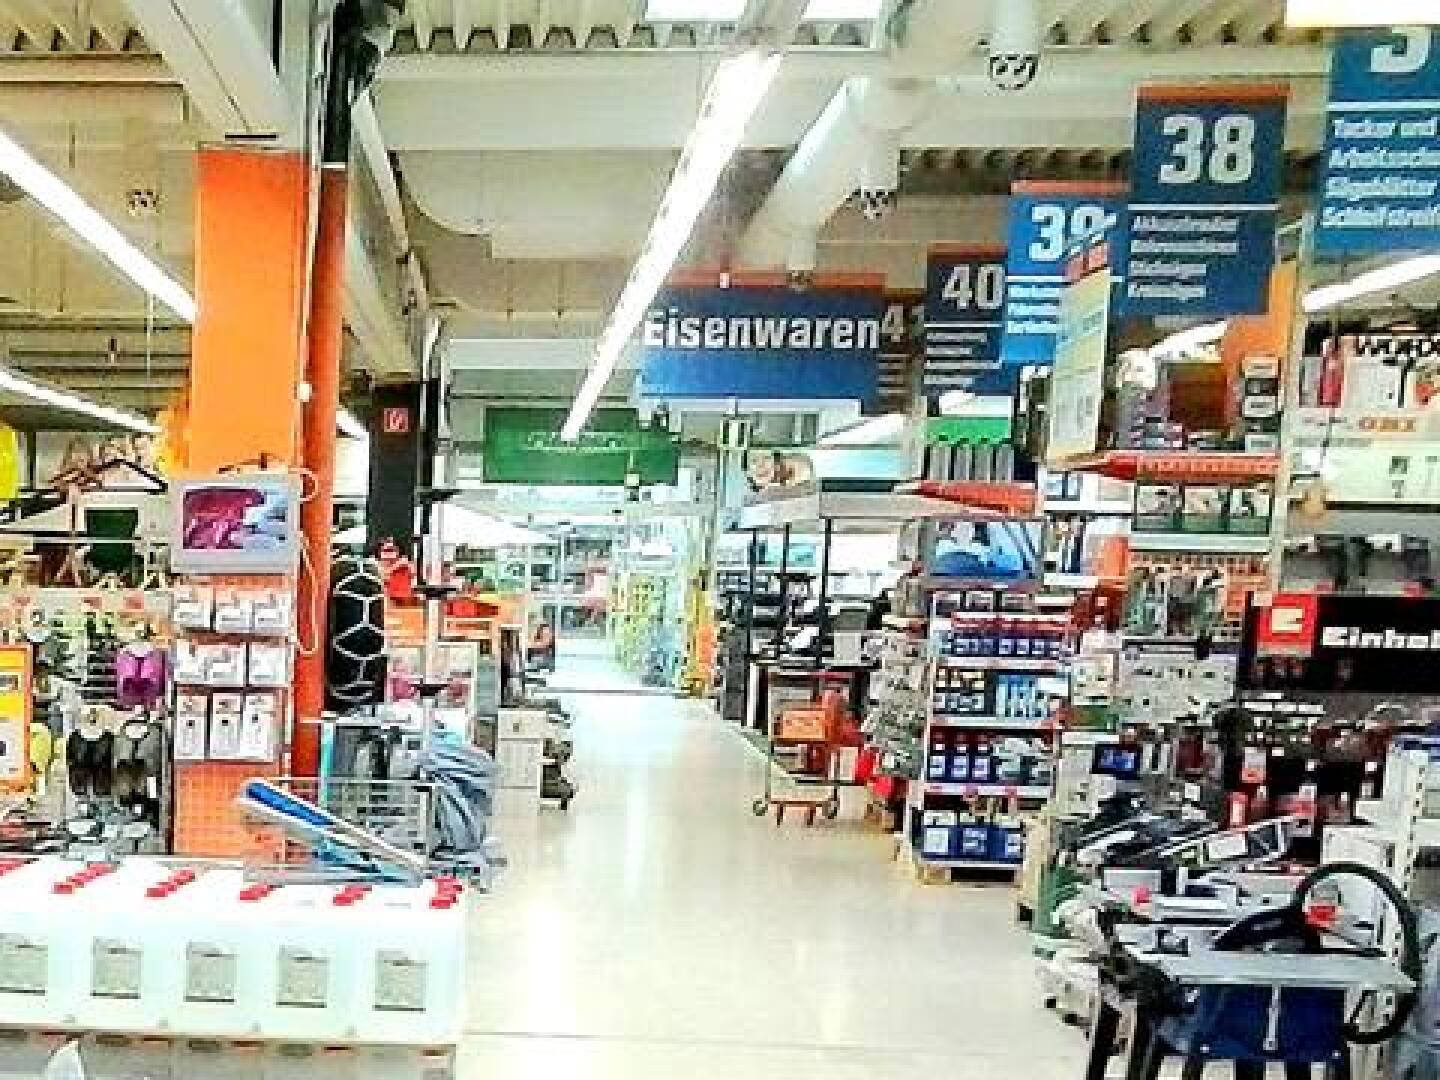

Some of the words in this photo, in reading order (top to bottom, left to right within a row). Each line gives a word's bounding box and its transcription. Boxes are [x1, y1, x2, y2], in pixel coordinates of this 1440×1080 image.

[1158, 113, 1255, 184] 38
[941, 263, 1006, 310] 40
[643, 306, 881, 350] Eisenwaren
